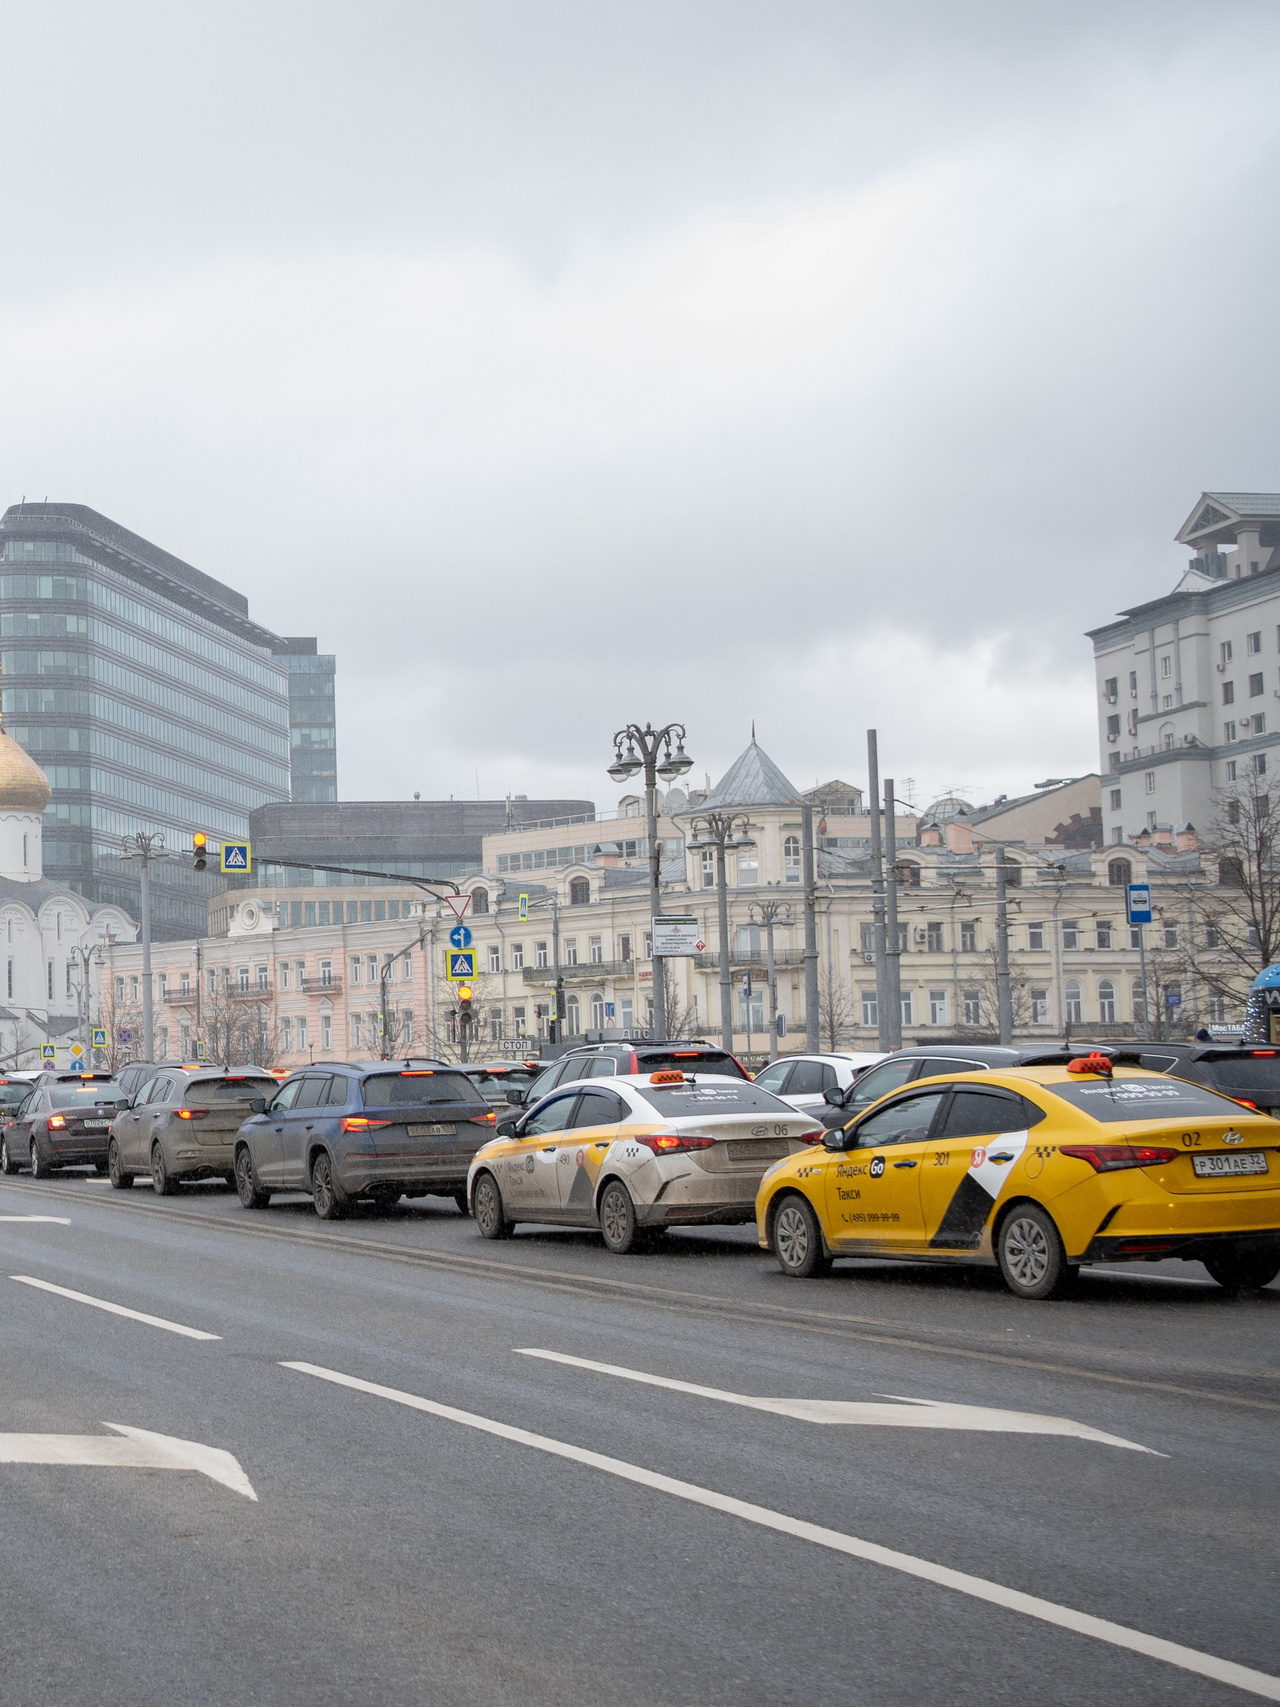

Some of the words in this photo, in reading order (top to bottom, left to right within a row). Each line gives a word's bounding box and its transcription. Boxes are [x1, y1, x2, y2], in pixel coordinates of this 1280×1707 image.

[621, 1029, 650, 1040] ДПС
[1211, 1024, 1246, 1032] МосТАБА
[503, 1041, 528, 1050] СТОП
[773, 1124, 789, 1136] 06
[1181, 1131, 1202, 1148] 02
[559, 1153, 570, 1166] 490
[933, 1152, 950, 1167] 301
[1199, 1156, 1248, 1172] Р301АЕ
[1248, 1154, 1262, 1165] 32
[836, 1163, 869, 1179] Яндекс
[870, 1159, 884, 1176] Go
[836, 1186, 861, 1201] Такси
[867, 1212, 900, 1223] 999-99-99
